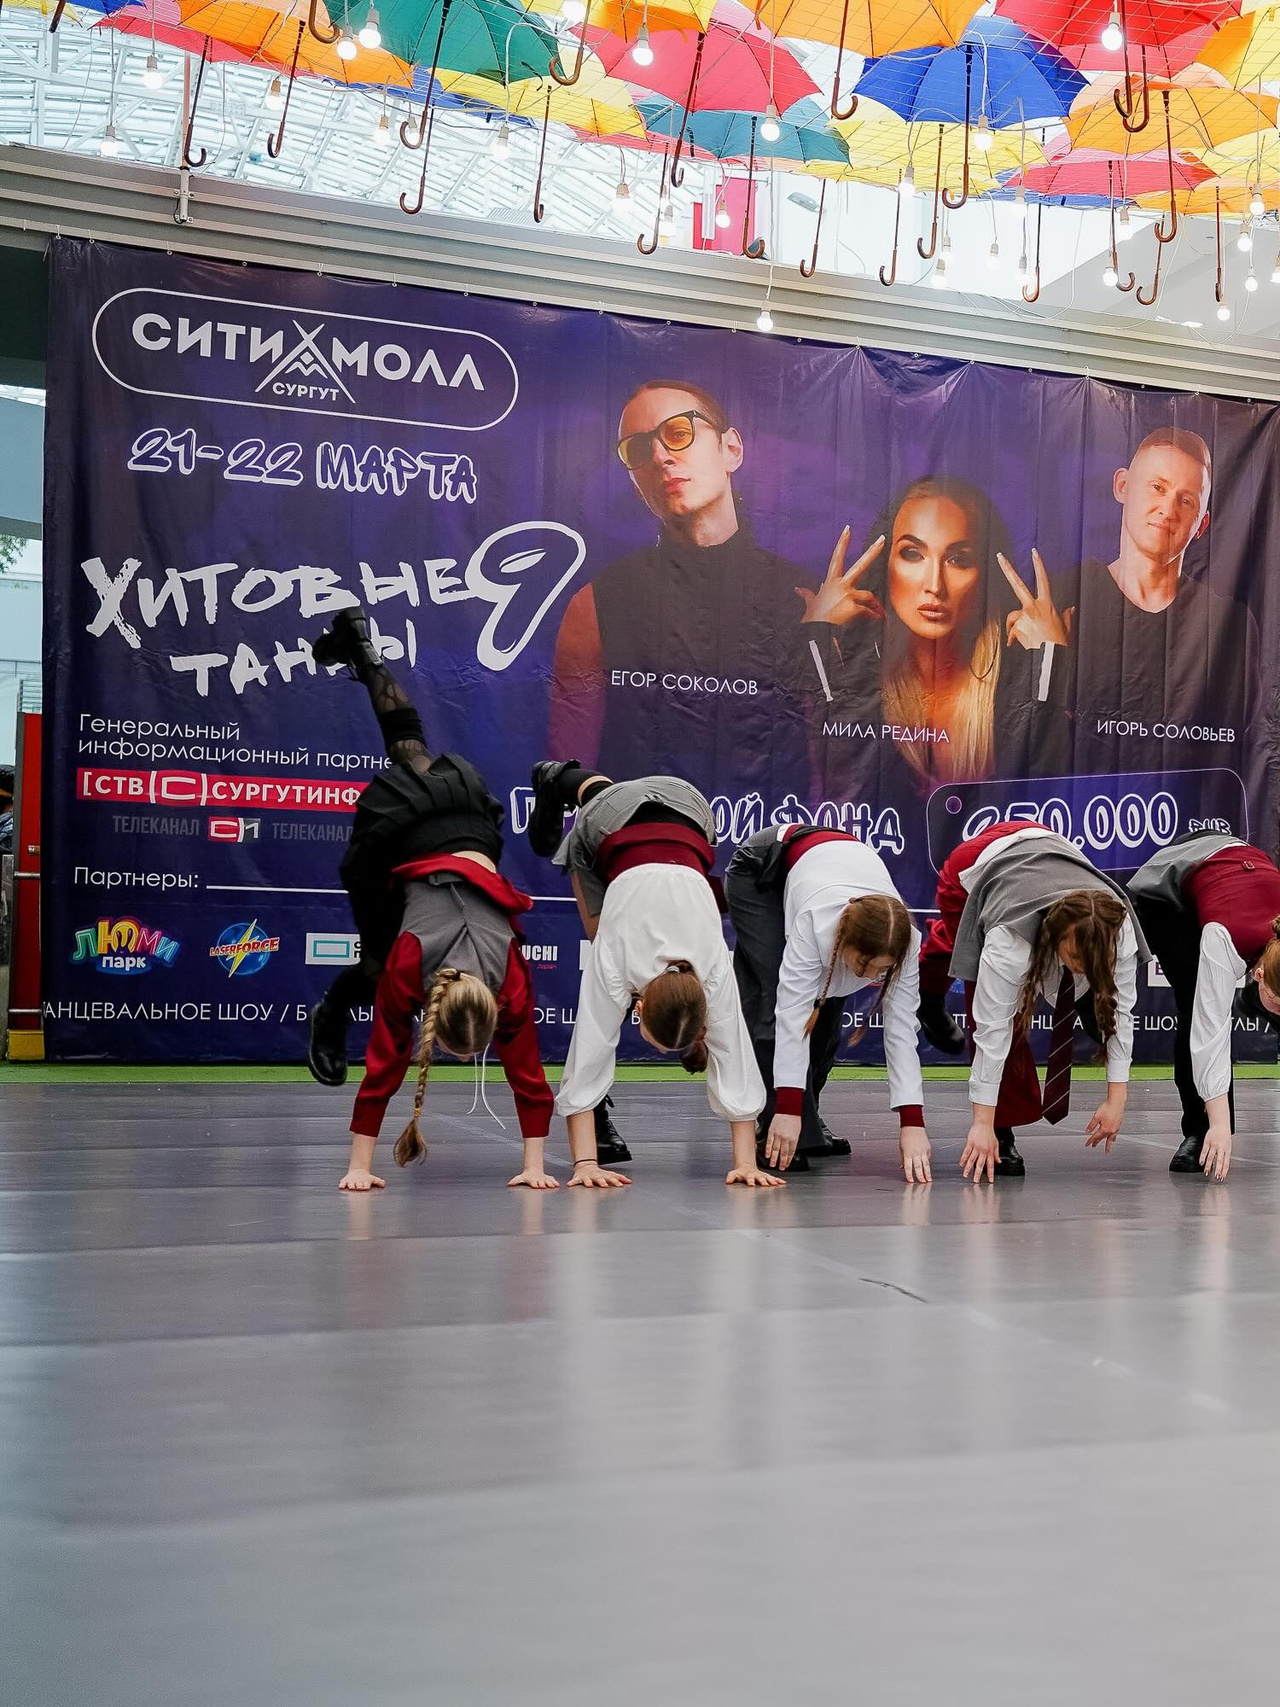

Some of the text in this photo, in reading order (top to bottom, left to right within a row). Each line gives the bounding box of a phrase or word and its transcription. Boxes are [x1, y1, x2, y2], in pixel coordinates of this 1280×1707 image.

[132, 313, 485, 391] СИТИ МОЛЛ
[272, 381, 339, 401] СУРГУТ
[127, 427, 478, 503] 21-22 МАРТА
[81, 557, 467, 648] ХИТОВЫЕ
[169, 617, 417, 697] ТАНЫ
[611, 670, 758, 695] ЕГОР СОКОЛОВ
[79, 714, 240, 741] Генеральный
[822, 721, 950, 743] МИЛА РЕДИНА
[1097, 719, 1235, 743] ИГОРЬ СОЛОВЬЕВ
[78, 737, 393, 772] информационный партне
[211, 780, 362, 806] СУРГУТИНФ
[112, 815, 199, 836] ТЕЛЕКАНАЛ
[74, 867, 200, 890] Партнеры:
[72, 919, 181, 963] ЛЮМИ
[209, 937, 280, 957] LASERFORCE
[518, 944, 558, 961] UCHI
[102, 955, 147, 971] парк
[218, 1003, 273, 1022] ШОУ
